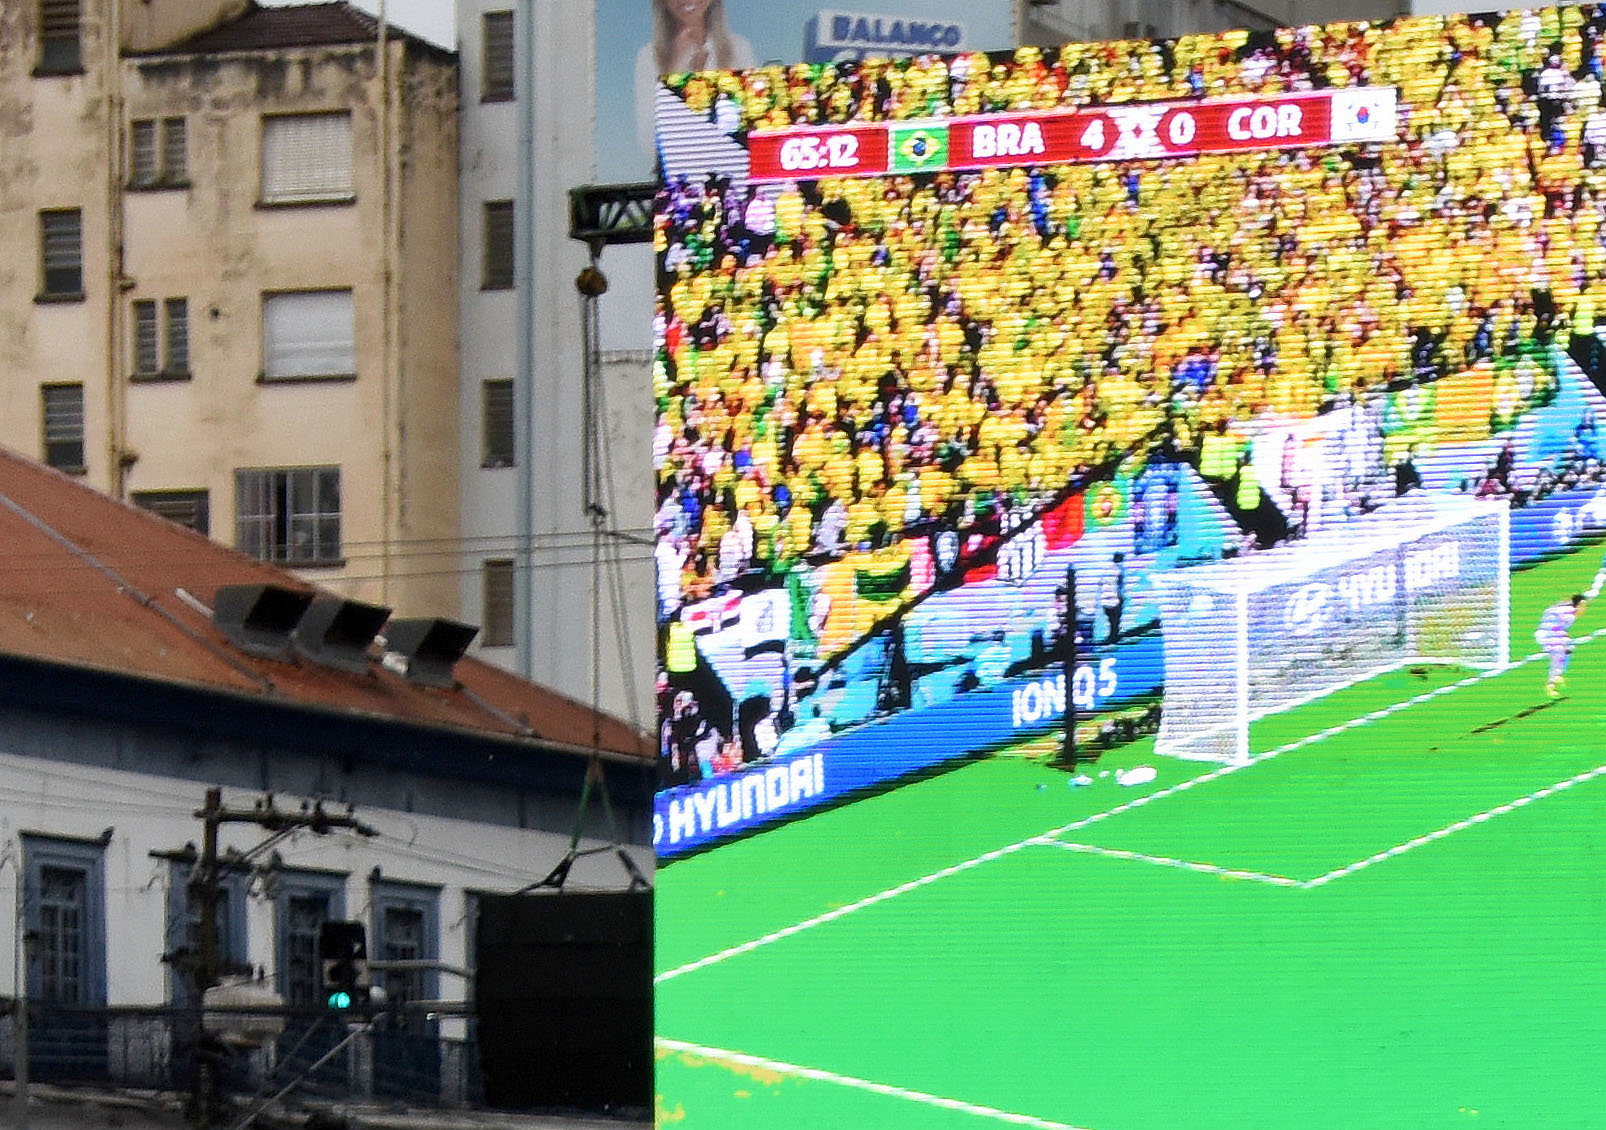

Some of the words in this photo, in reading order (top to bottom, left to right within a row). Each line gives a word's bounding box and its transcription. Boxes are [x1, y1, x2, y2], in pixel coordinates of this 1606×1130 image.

[780, 134, 859, 170] 65:12
[972, 122, 1045, 158] BRA
[1080, 119, 1104, 150] 4
[1168, 112, 1196, 145] 0
[1227, 103, 1303, 140] COR
[1012, 666, 1095, 728] IONQ
[1098, 657, 1117, 697] 5
[669, 753, 825, 845] HYUNDAI
